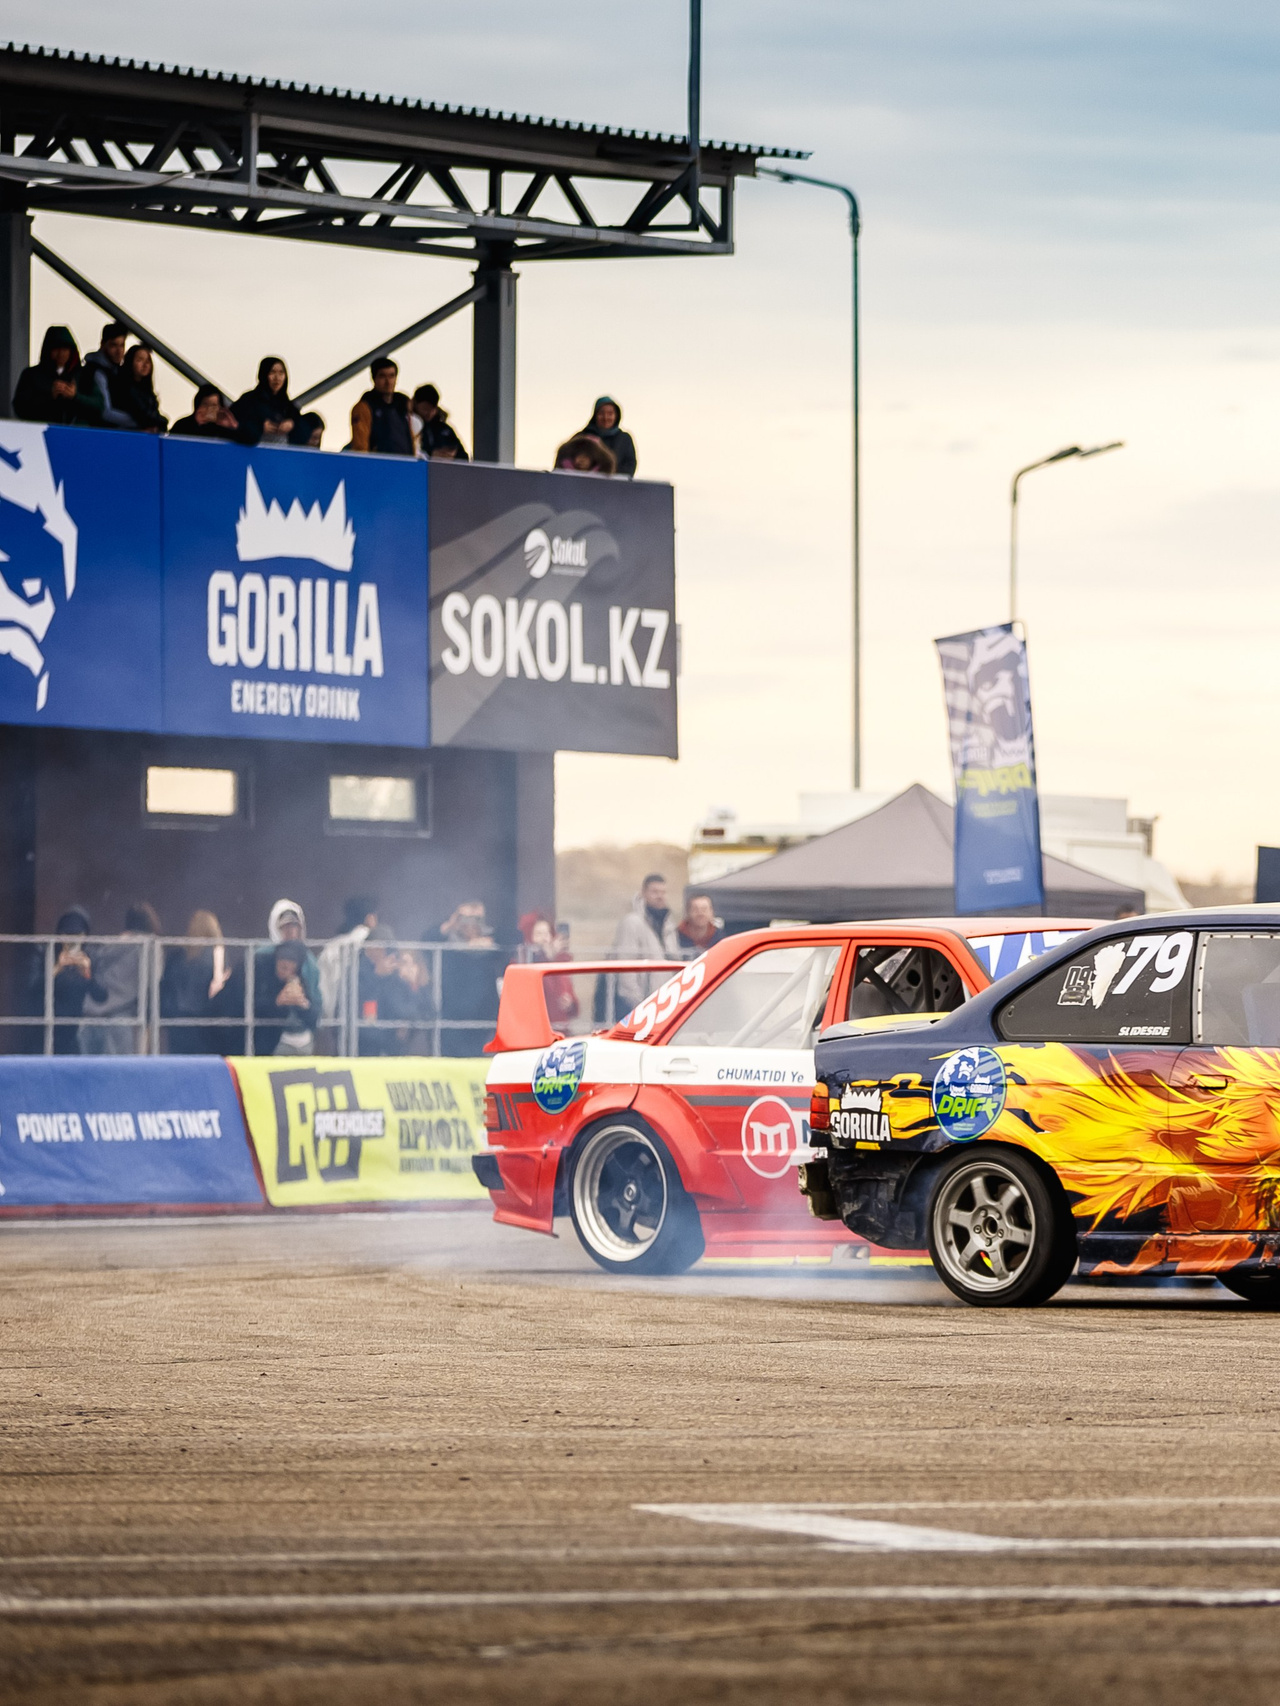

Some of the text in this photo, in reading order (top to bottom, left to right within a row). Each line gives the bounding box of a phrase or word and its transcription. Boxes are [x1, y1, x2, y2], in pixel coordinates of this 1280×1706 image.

[207, 570, 384, 678] GORILLA
[441, 591, 671, 689] SOKOL.KZ
[231, 680, 360, 722] ENERGY DRINK
[1112, 931, 1194, 995] 79
[633, 951, 708, 1041] 555
[1118, 1026, 1171, 1036] SLIDESIDE
[717, 1068, 804, 1083] CHUMATIDI Ye
[386, 1081, 460, 1112] ШКОЛА
[937, 1094, 998, 1121] DRIFT
[16, 1109, 222, 1143] POWER YOUR INSTINCT
[399, 1118, 476, 1151] ДРИФТА
[830, 1111, 891, 1142] GORILLA
